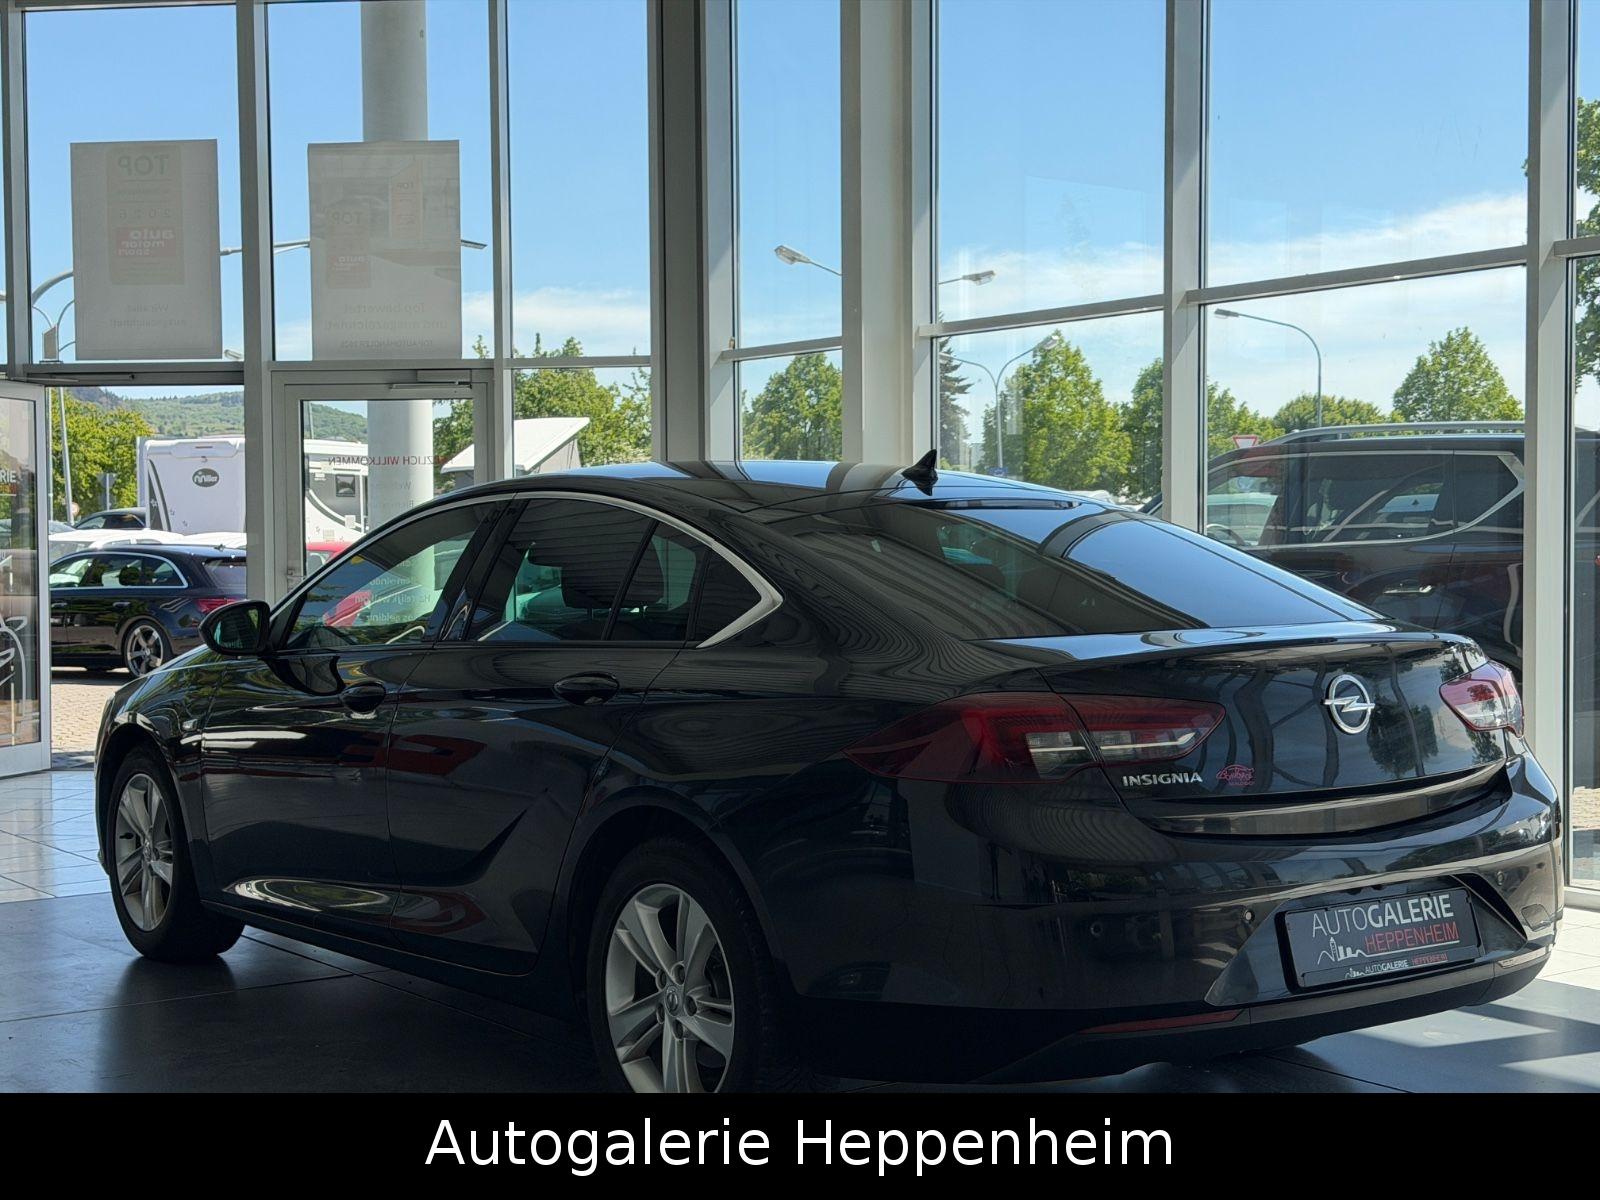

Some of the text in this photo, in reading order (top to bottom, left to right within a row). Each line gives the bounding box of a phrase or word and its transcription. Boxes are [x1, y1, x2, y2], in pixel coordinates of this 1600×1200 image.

[1122, 772, 1204, 786] INSIGNIA
[1311, 892, 1455, 938] AUTOGALERIE
[1364, 920, 1461, 954] HEPPENHEIM
